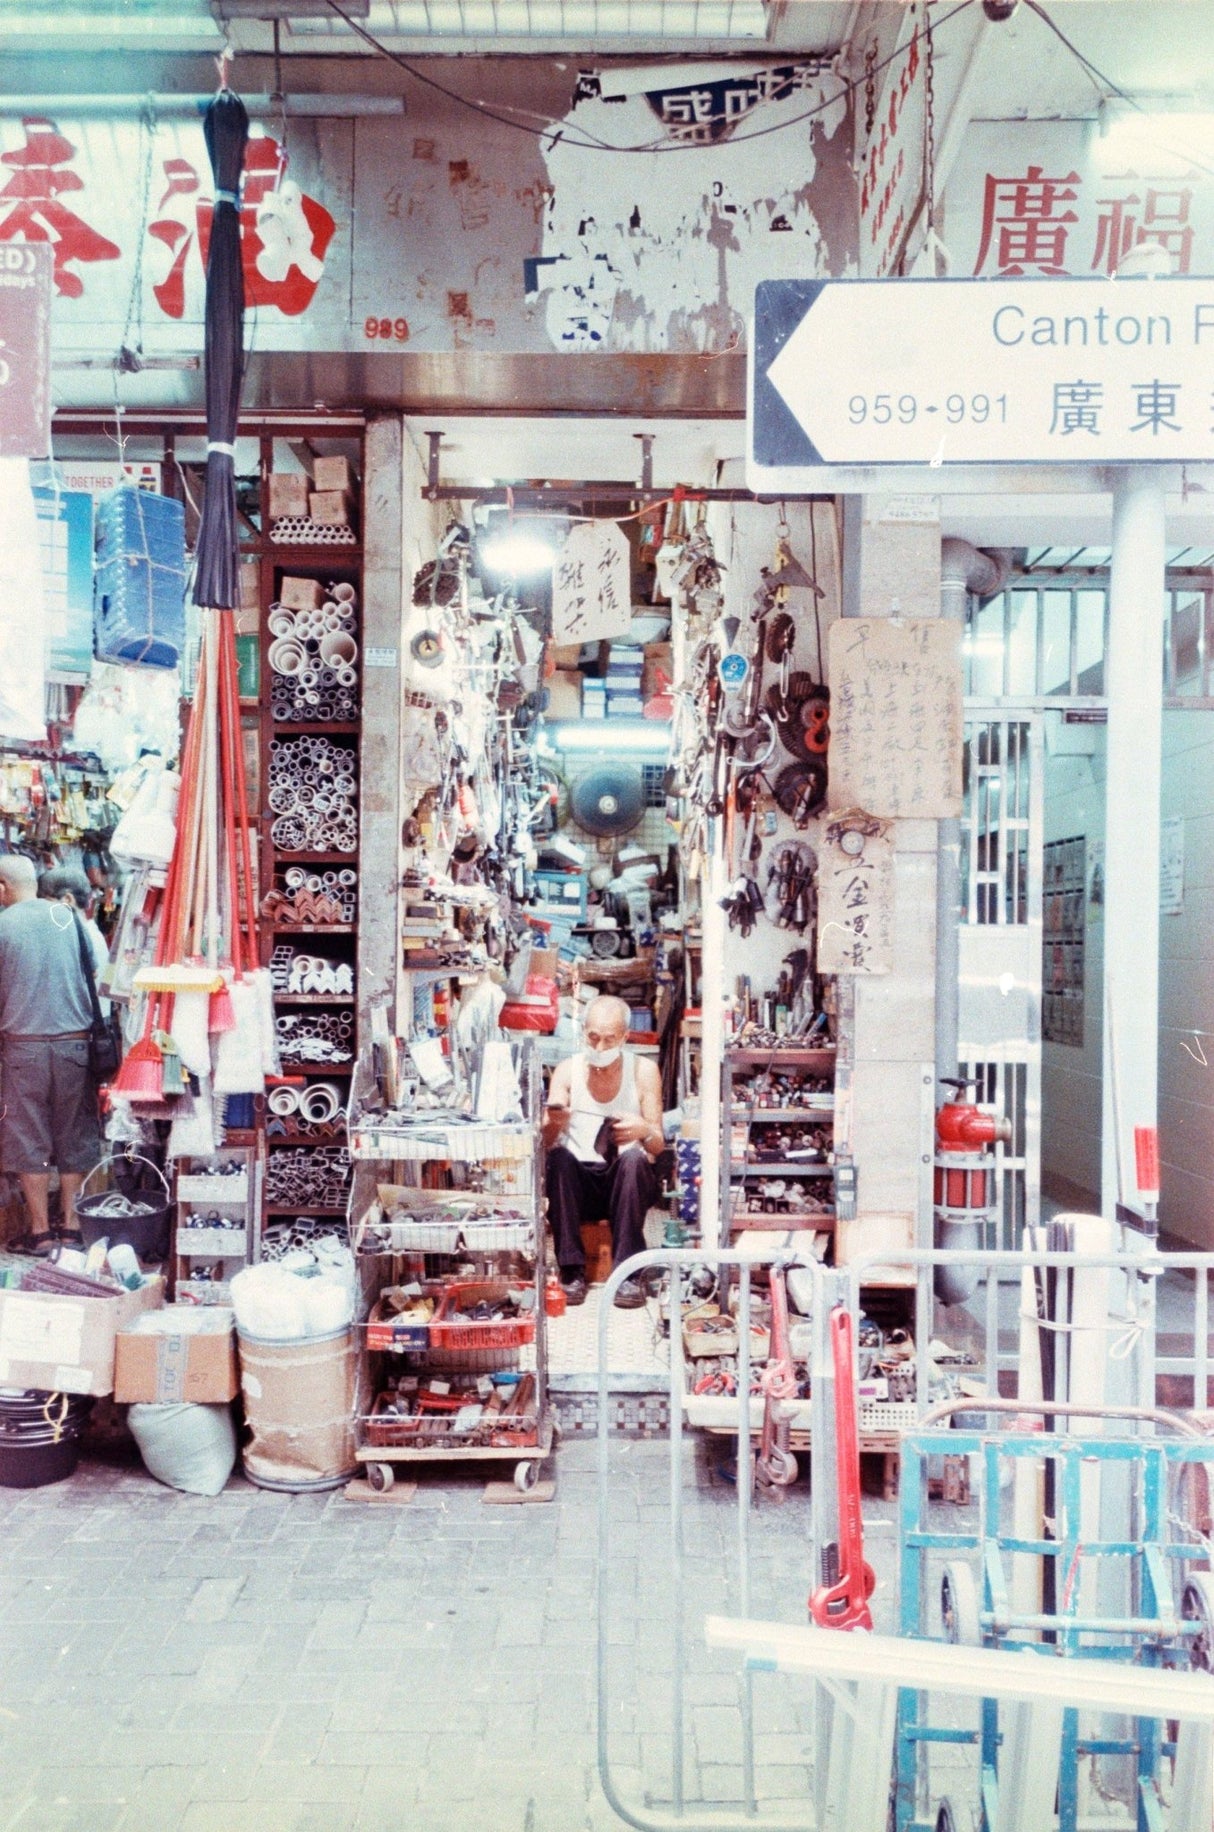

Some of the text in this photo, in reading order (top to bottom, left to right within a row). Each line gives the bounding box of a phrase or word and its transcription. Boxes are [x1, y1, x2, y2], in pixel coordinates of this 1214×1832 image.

[993, 305, 1172, 346] Canton
[1049, 379, 1214, 436] 廣東
[65, 475, 114, 489] TOGETHER
